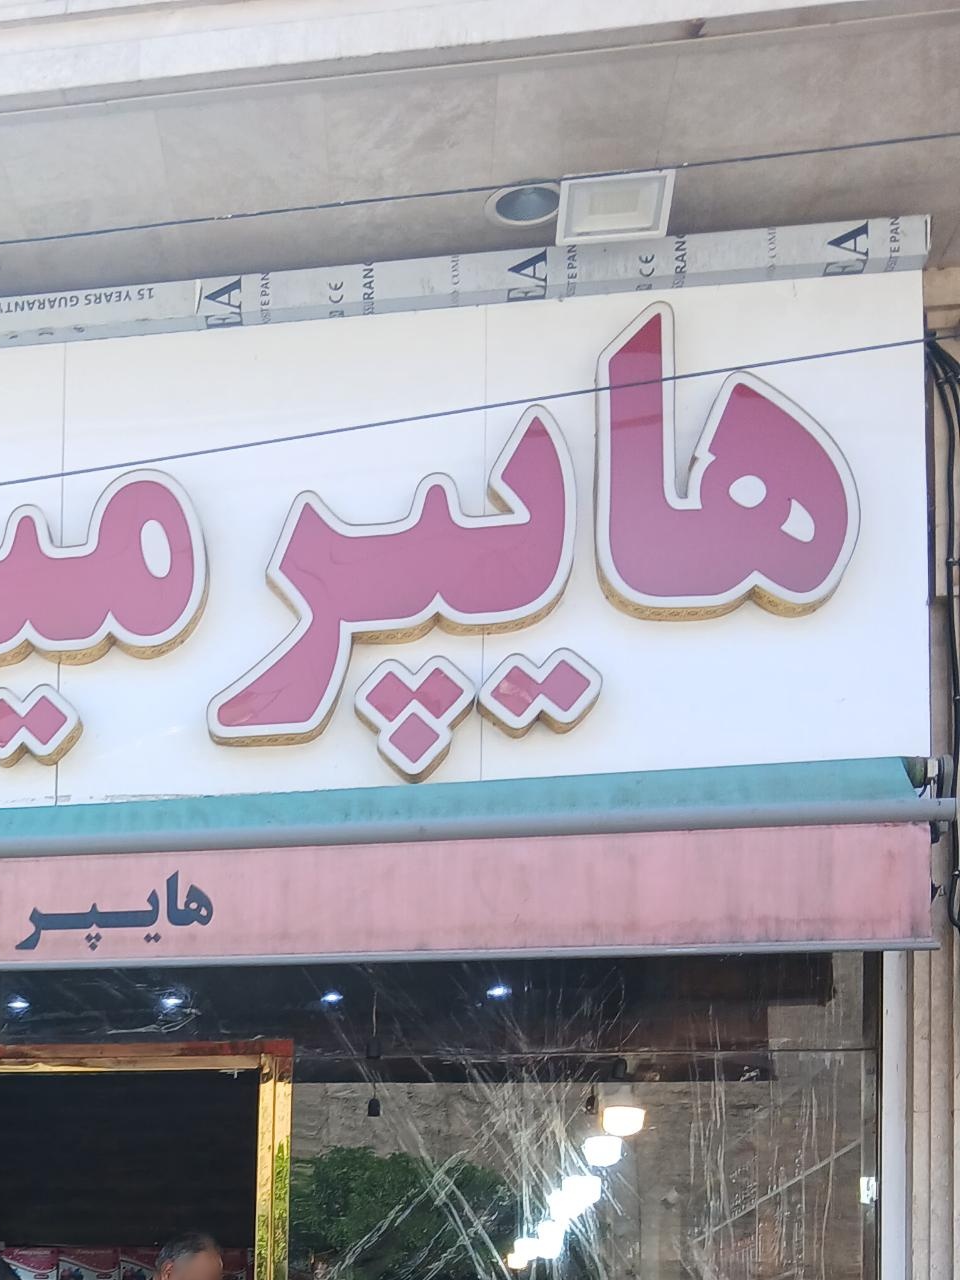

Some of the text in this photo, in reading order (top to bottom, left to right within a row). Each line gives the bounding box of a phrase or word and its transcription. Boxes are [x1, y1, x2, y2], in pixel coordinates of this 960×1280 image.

[84, 291, 132, 306] YEARS
[138, 287, 155, 300] 15
[207, 300, 862, 783] هایپر
[14, 870, 215, 952] هایپر
